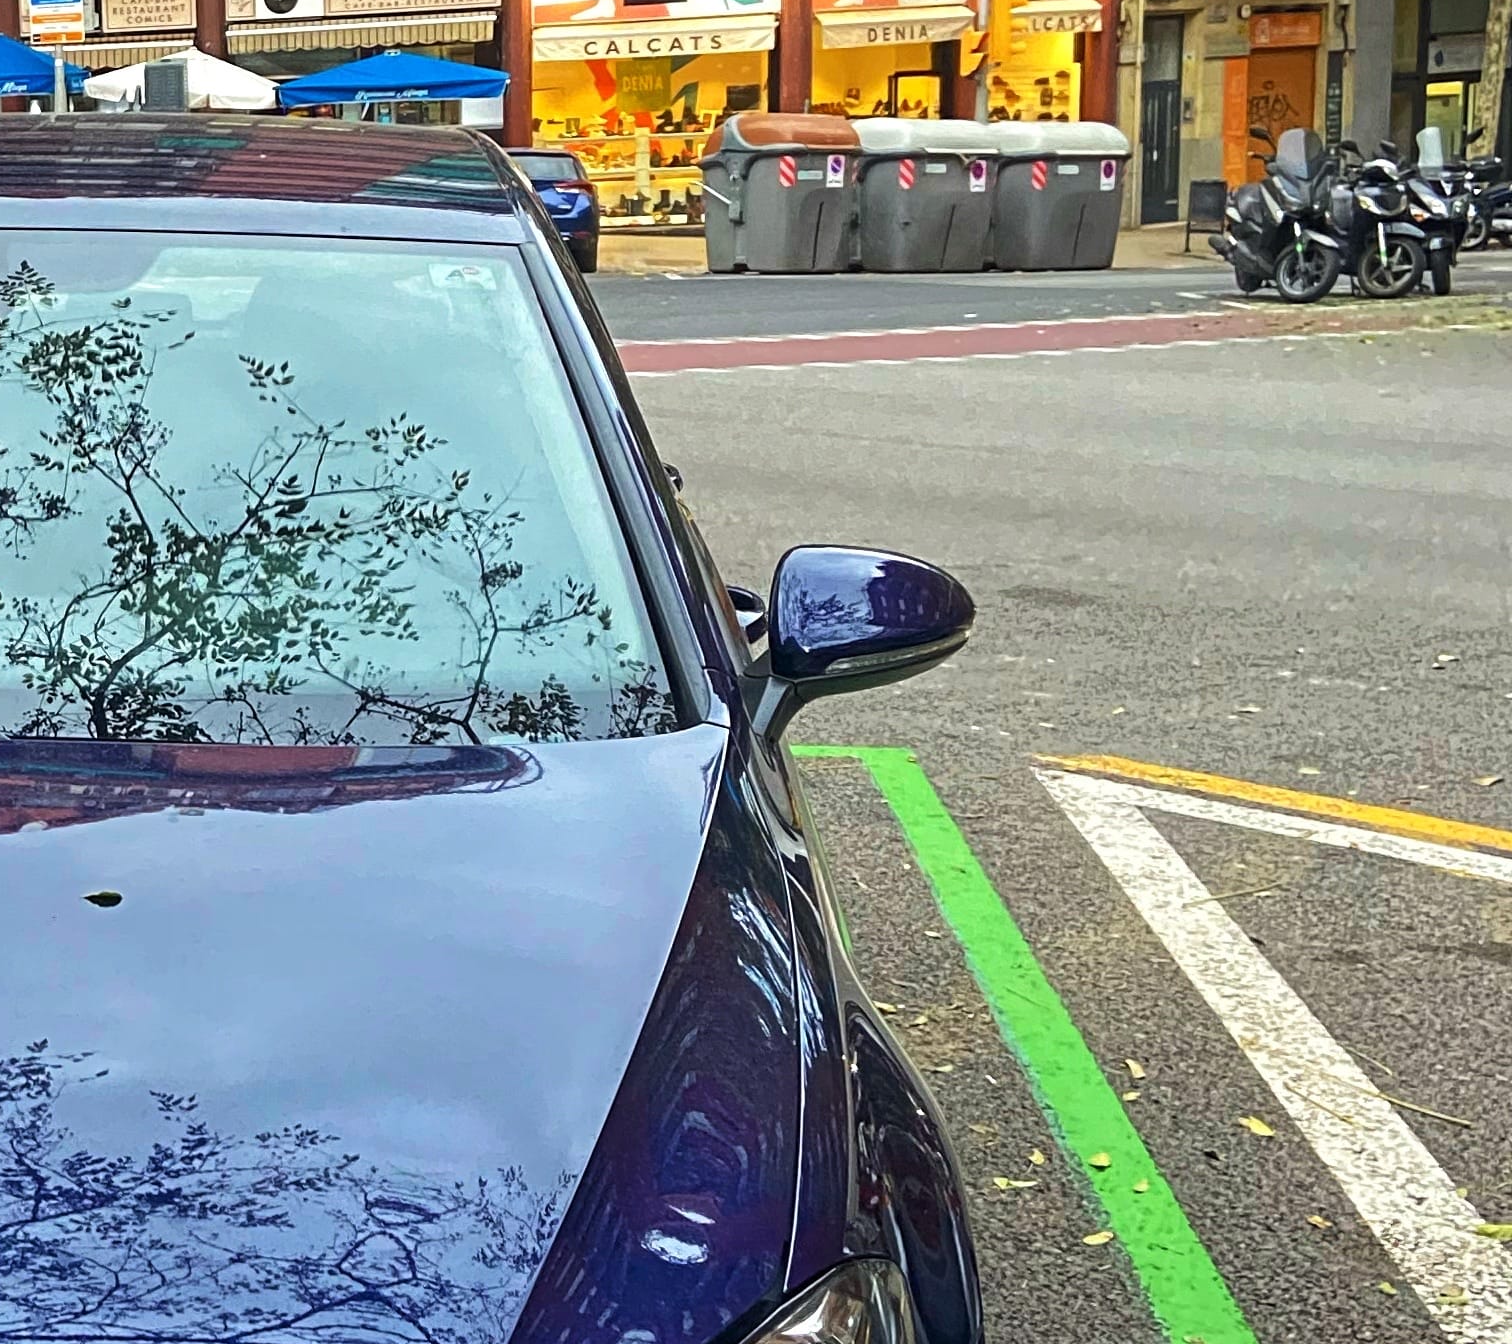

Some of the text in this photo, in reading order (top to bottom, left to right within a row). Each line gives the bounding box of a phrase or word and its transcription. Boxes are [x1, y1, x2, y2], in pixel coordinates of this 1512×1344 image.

[112, 3, 186, 16] RESTAURANT
[126, 14, 174, 25] COMICS
[867, 28, 930, 44] DENIA
[584, 35, 723, 56] CALÇATS
[622, 75, 664, 93] DENIA
